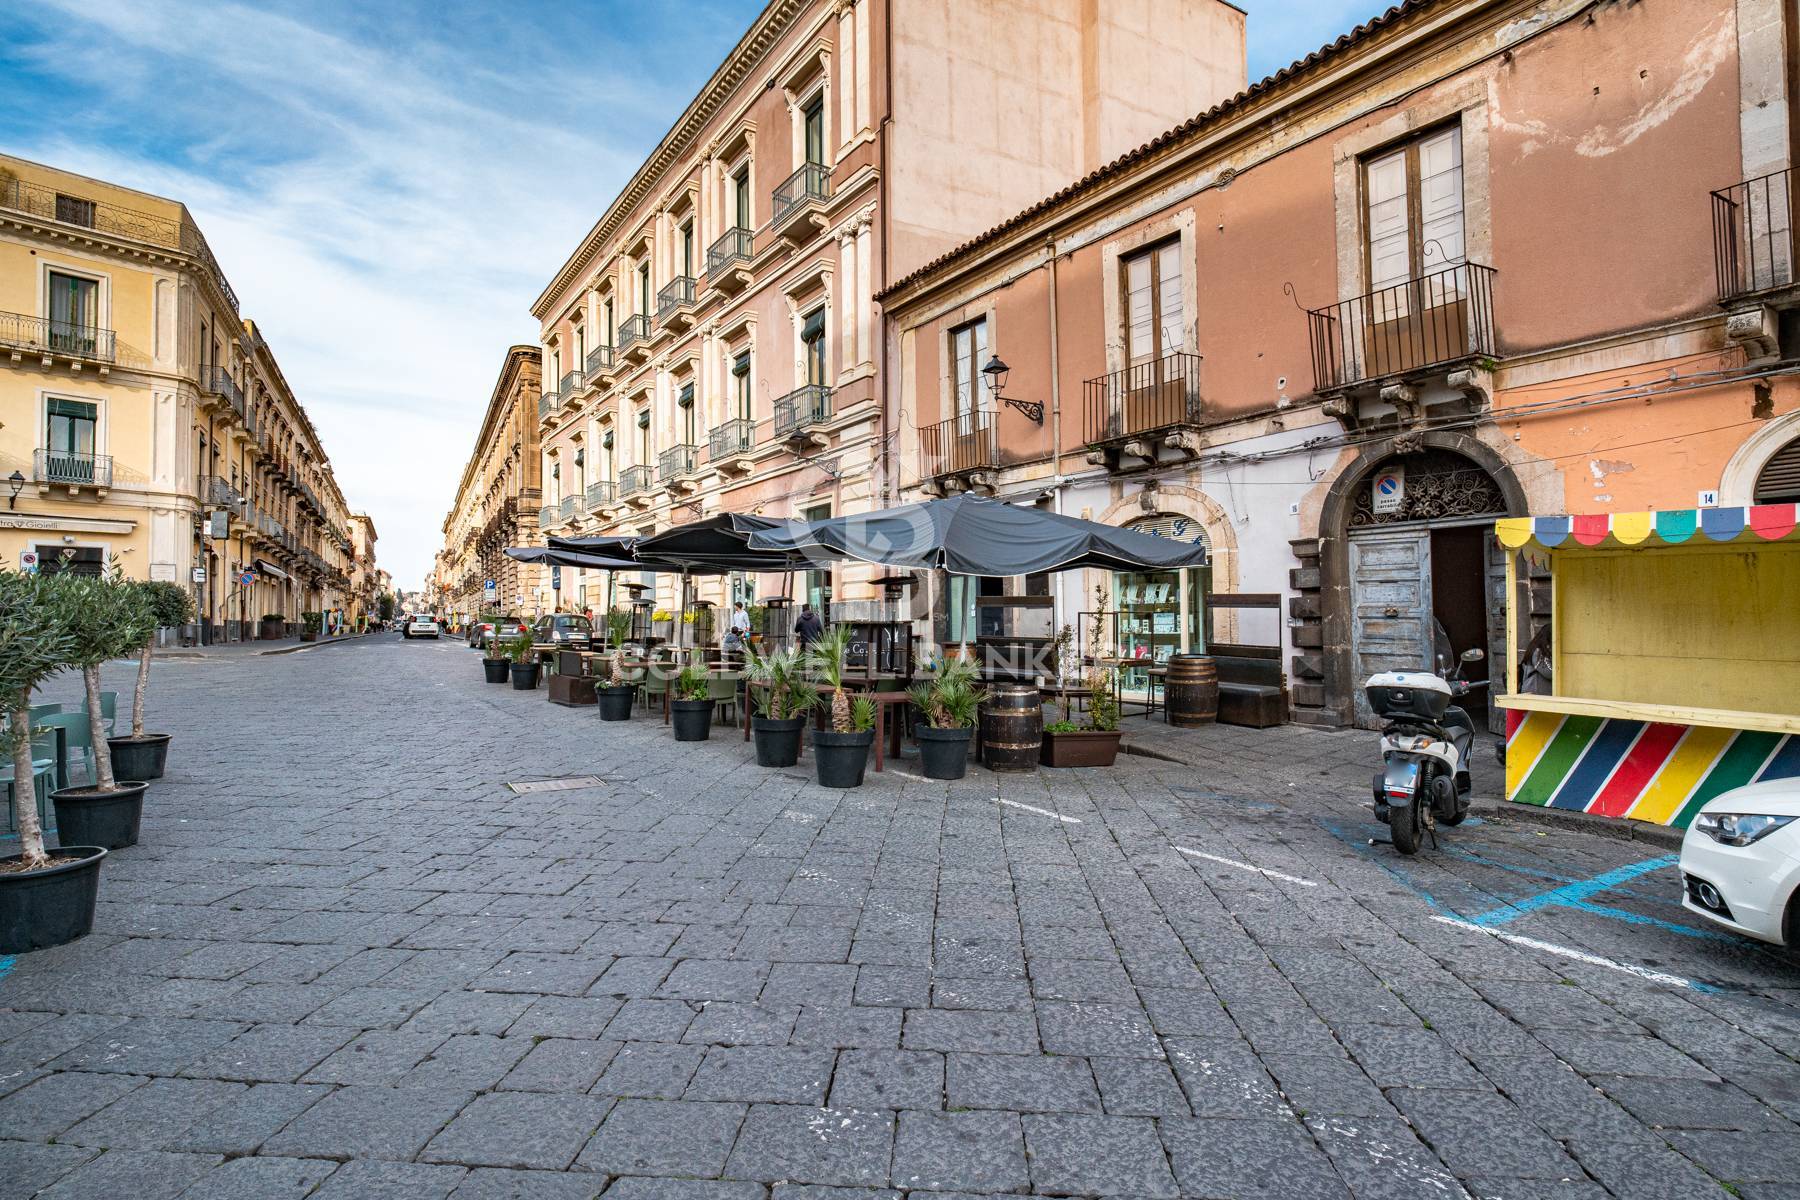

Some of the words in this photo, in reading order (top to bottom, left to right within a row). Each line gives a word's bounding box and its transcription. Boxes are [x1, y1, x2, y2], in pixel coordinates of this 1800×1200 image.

[1704, 494, 1713, 504] 14
[26, 520, 58, 529] Gioielli
[487, 581, 494, 589] P
